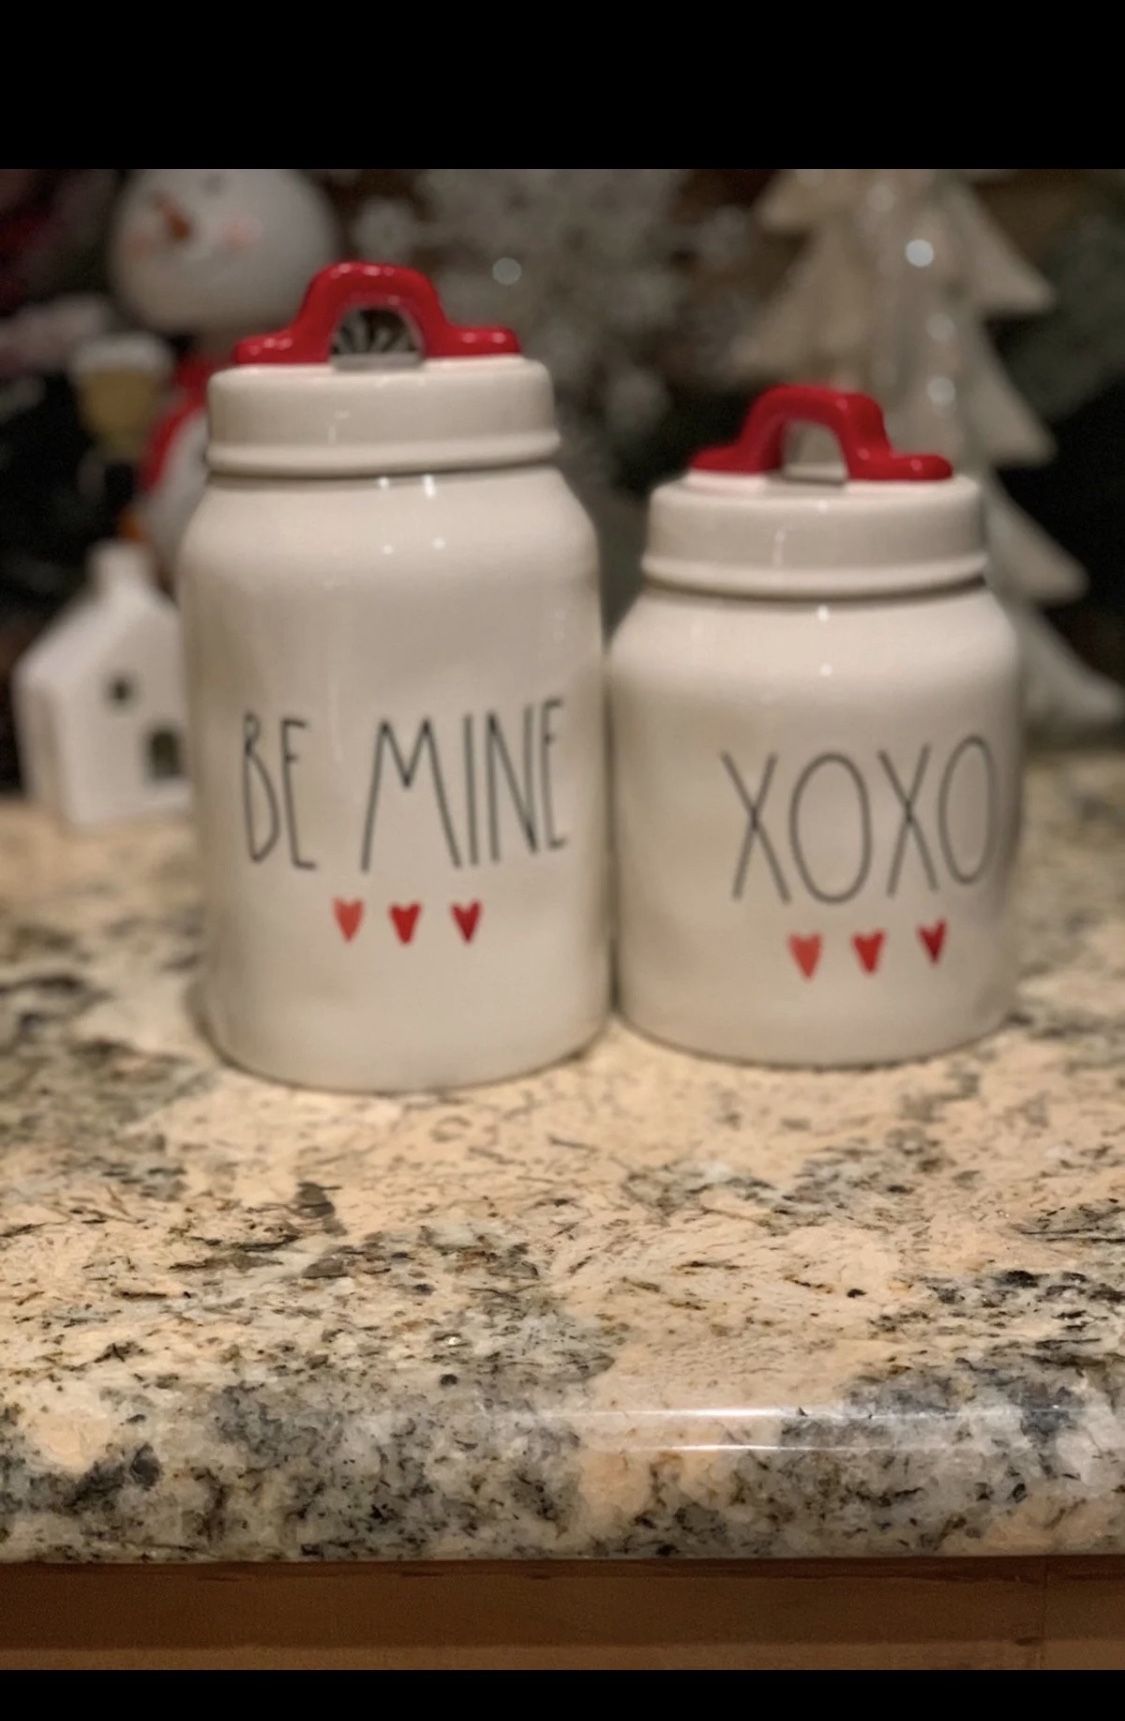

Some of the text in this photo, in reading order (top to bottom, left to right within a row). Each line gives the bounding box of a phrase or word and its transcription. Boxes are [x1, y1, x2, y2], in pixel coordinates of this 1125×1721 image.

[242, 698, 568, 874] BE MINE
[719, 734, 1000, 905] XOXO
